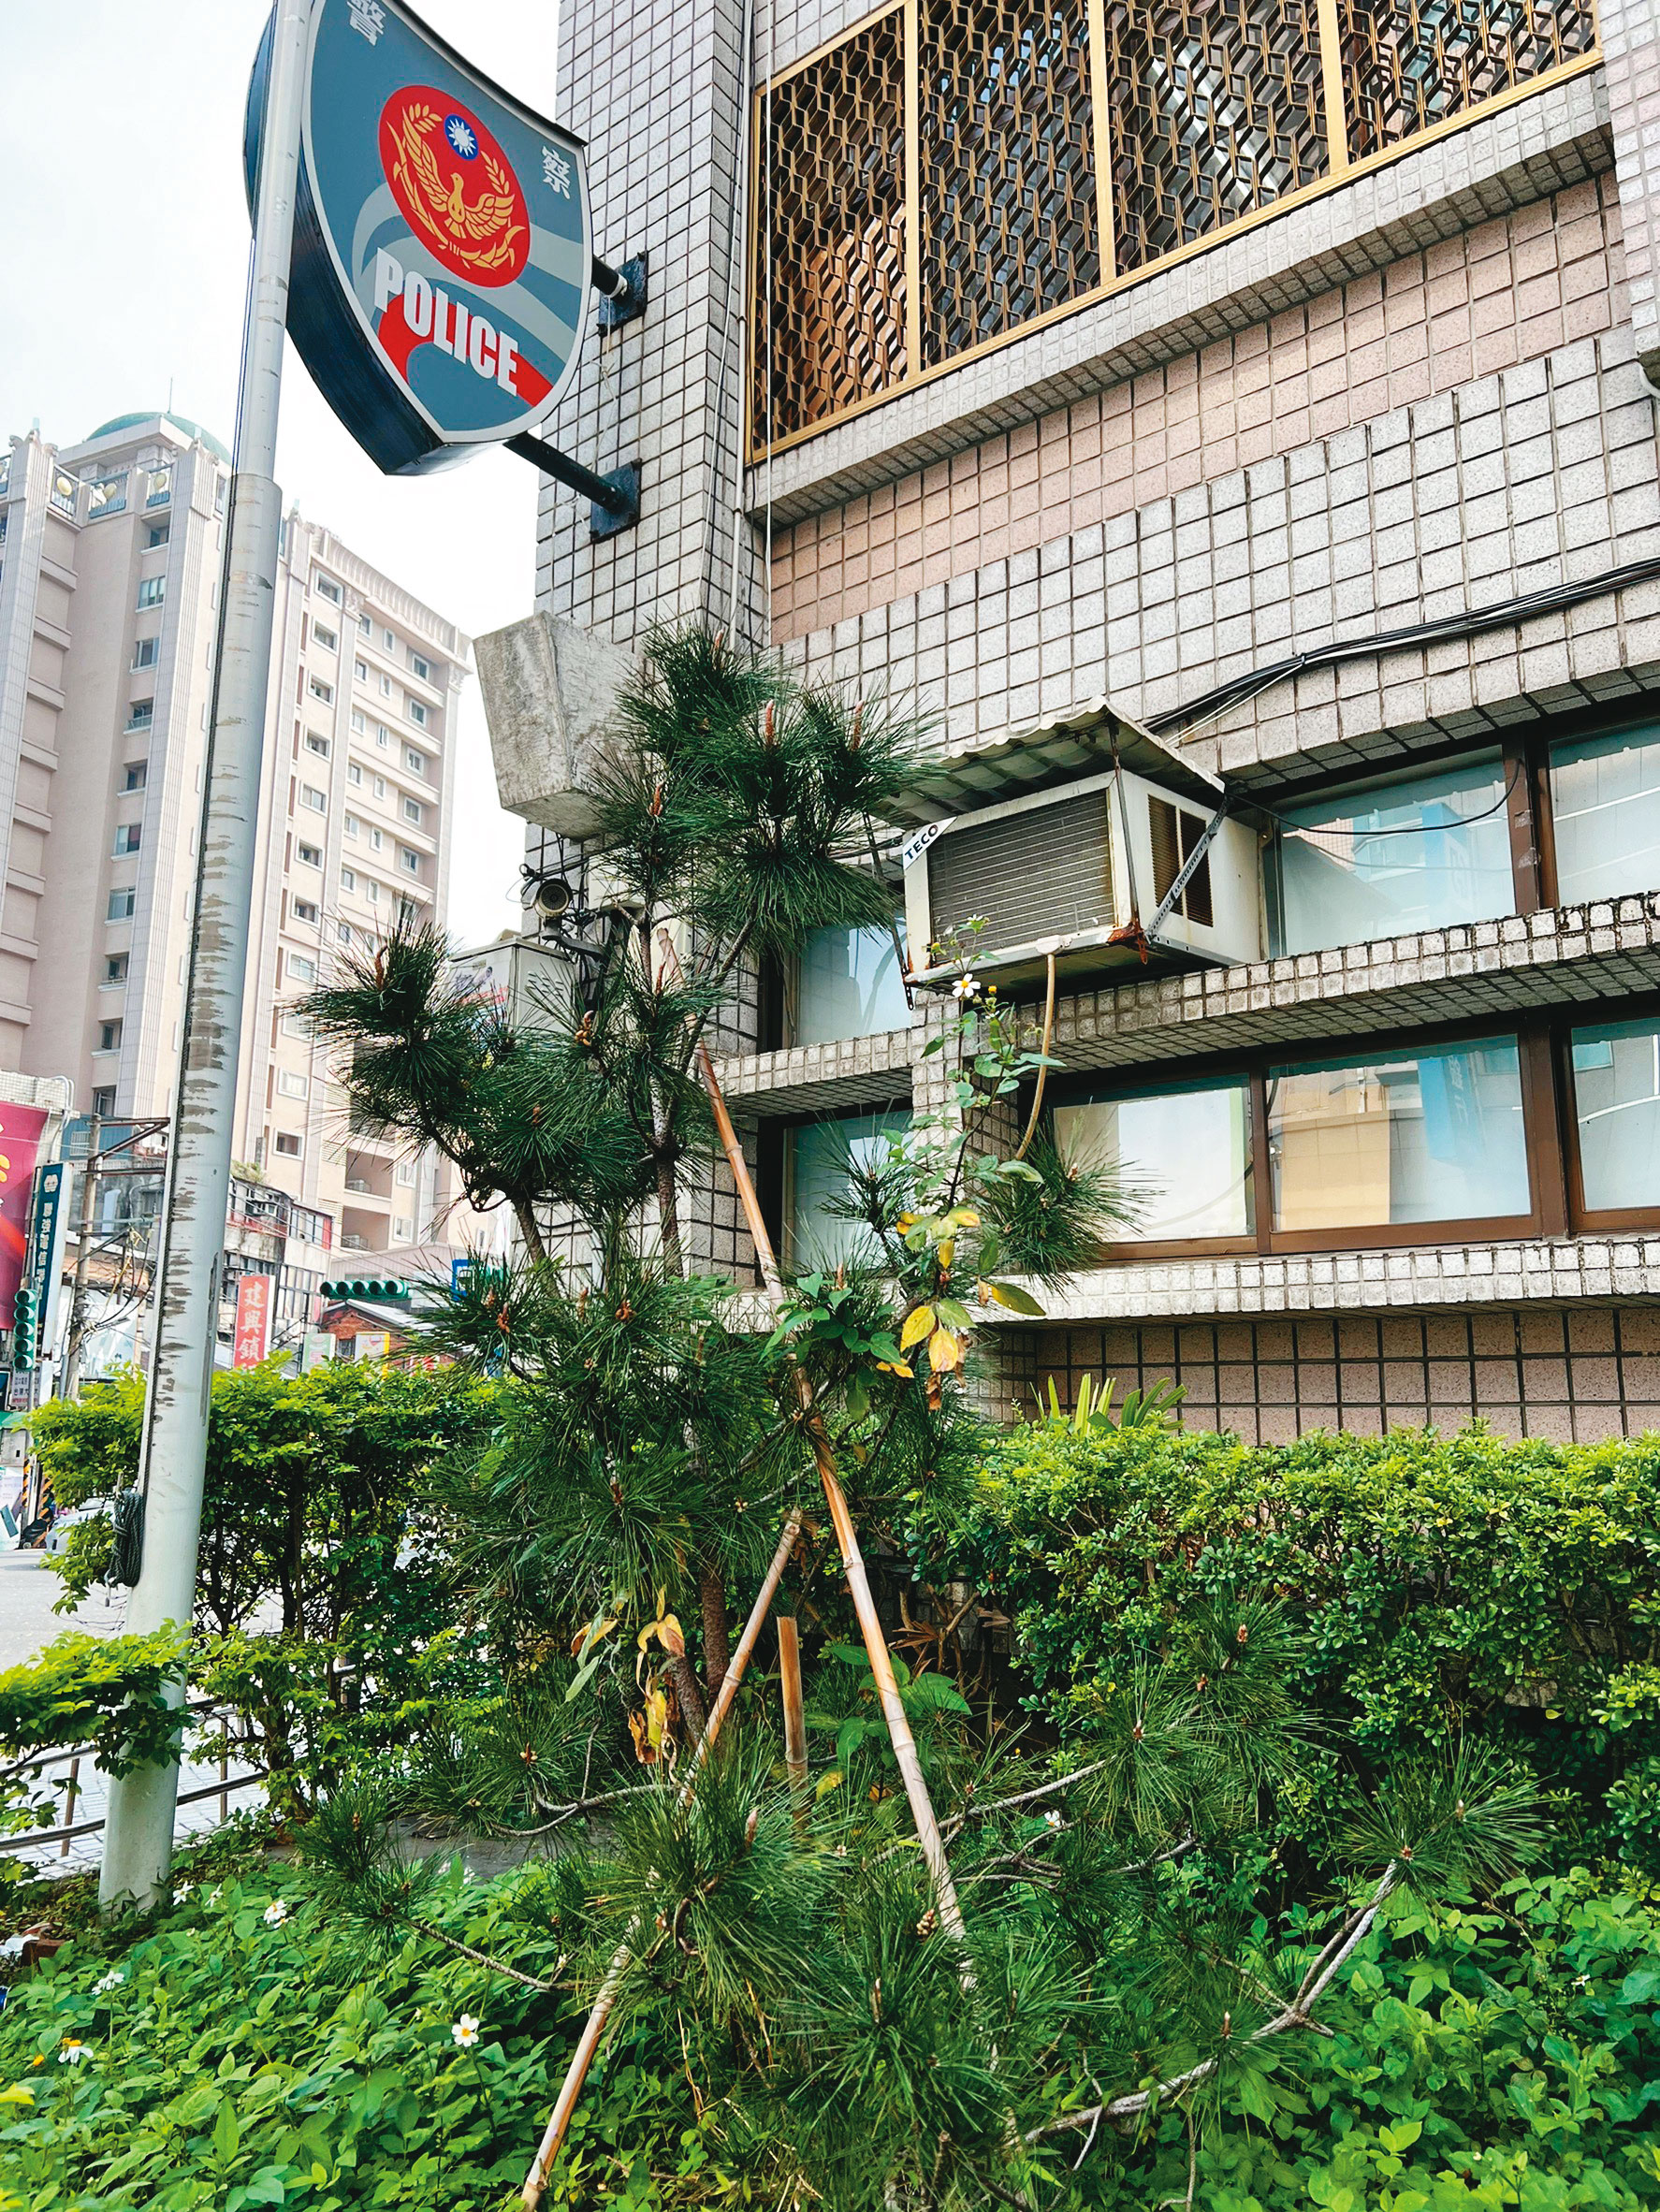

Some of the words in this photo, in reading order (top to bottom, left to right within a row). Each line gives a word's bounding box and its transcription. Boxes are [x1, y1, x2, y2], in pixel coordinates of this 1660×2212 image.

[346, 0, 386, 46] 警
[542, 145, 571, 199] 察
[374, 246, 518, 397] POLICE
[905, 824, 939, 860] TECO
